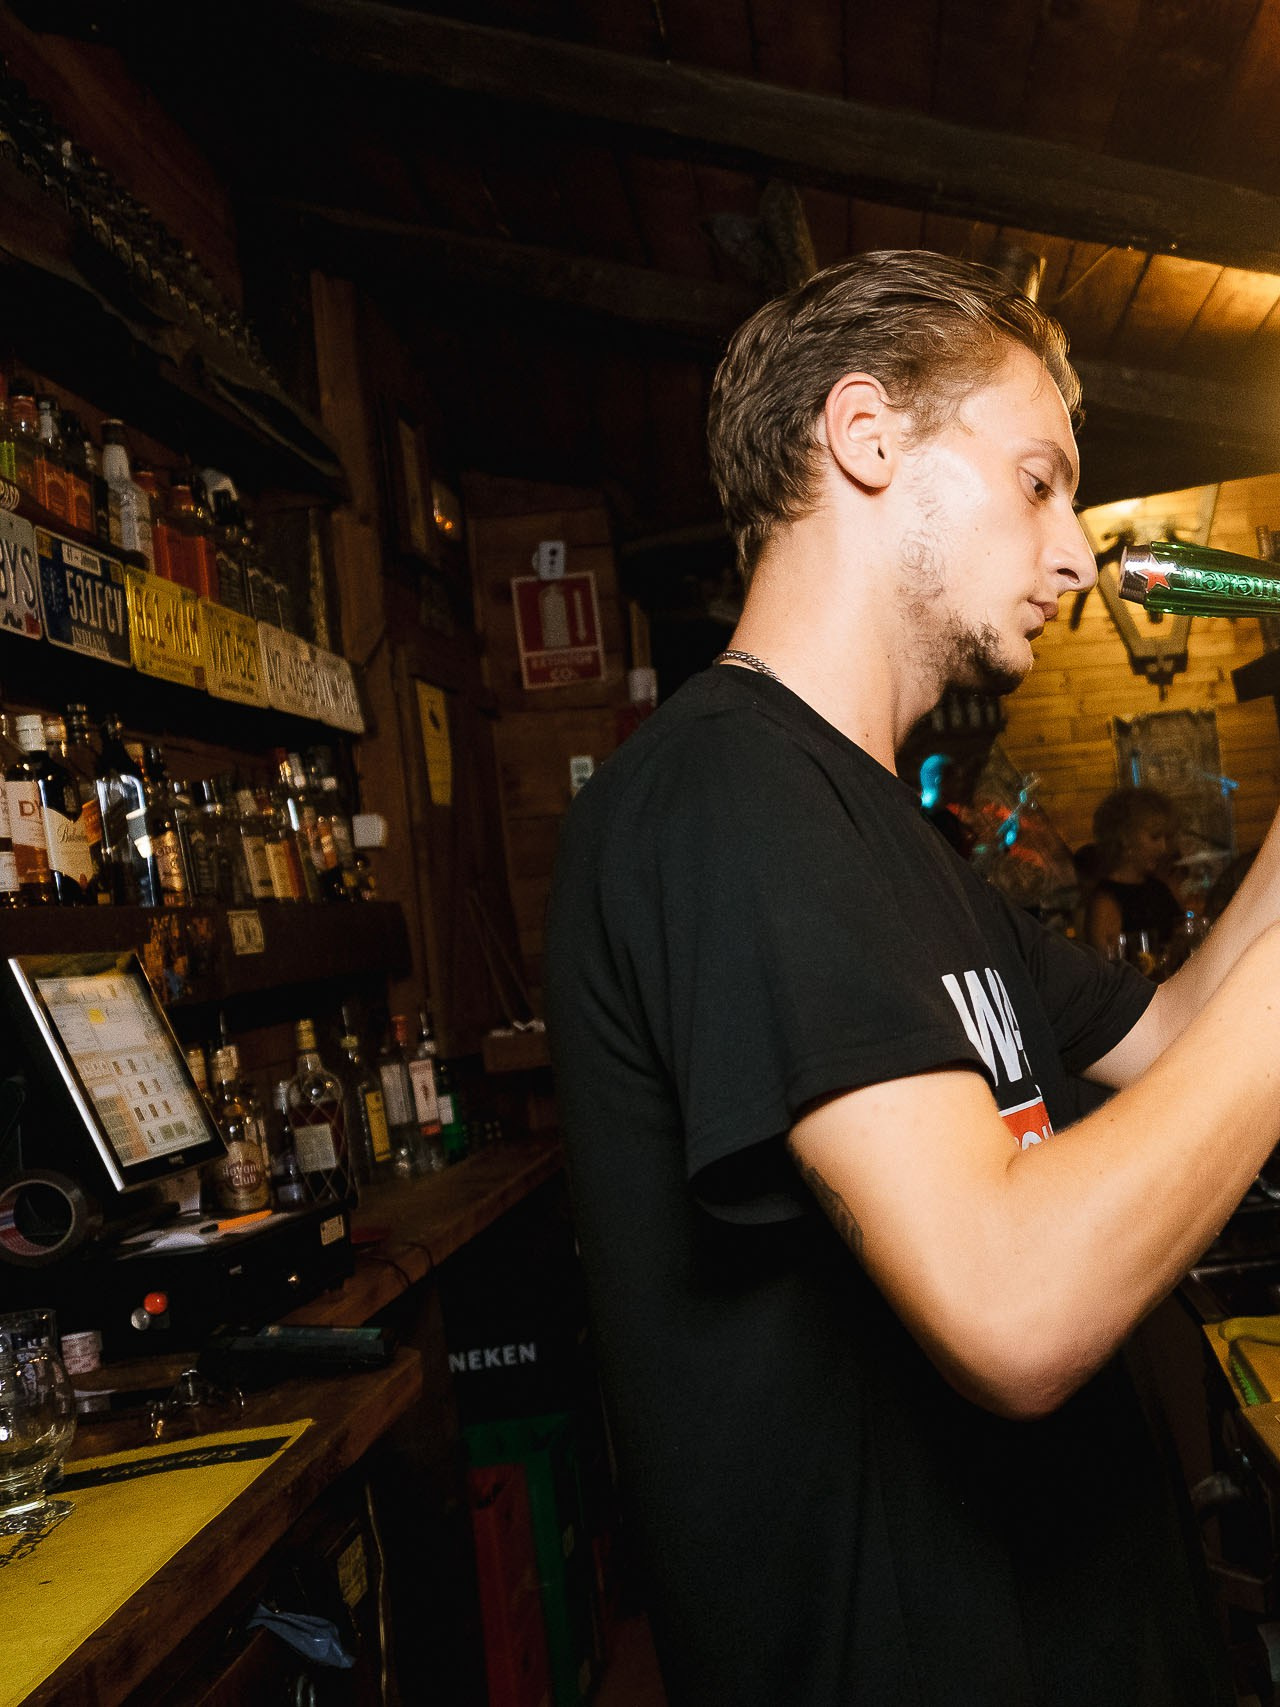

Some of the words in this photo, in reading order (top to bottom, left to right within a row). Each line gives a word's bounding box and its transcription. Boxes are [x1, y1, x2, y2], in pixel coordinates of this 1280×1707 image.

[65, 569, 123, 637] 531FCV
[71, 625, 108, 650] INDIANA
[222, 1159, 261, 1178] Havana
[231, 1172, 258, 1189] Club
[448, 1341, 537, 1373] NEKEN
